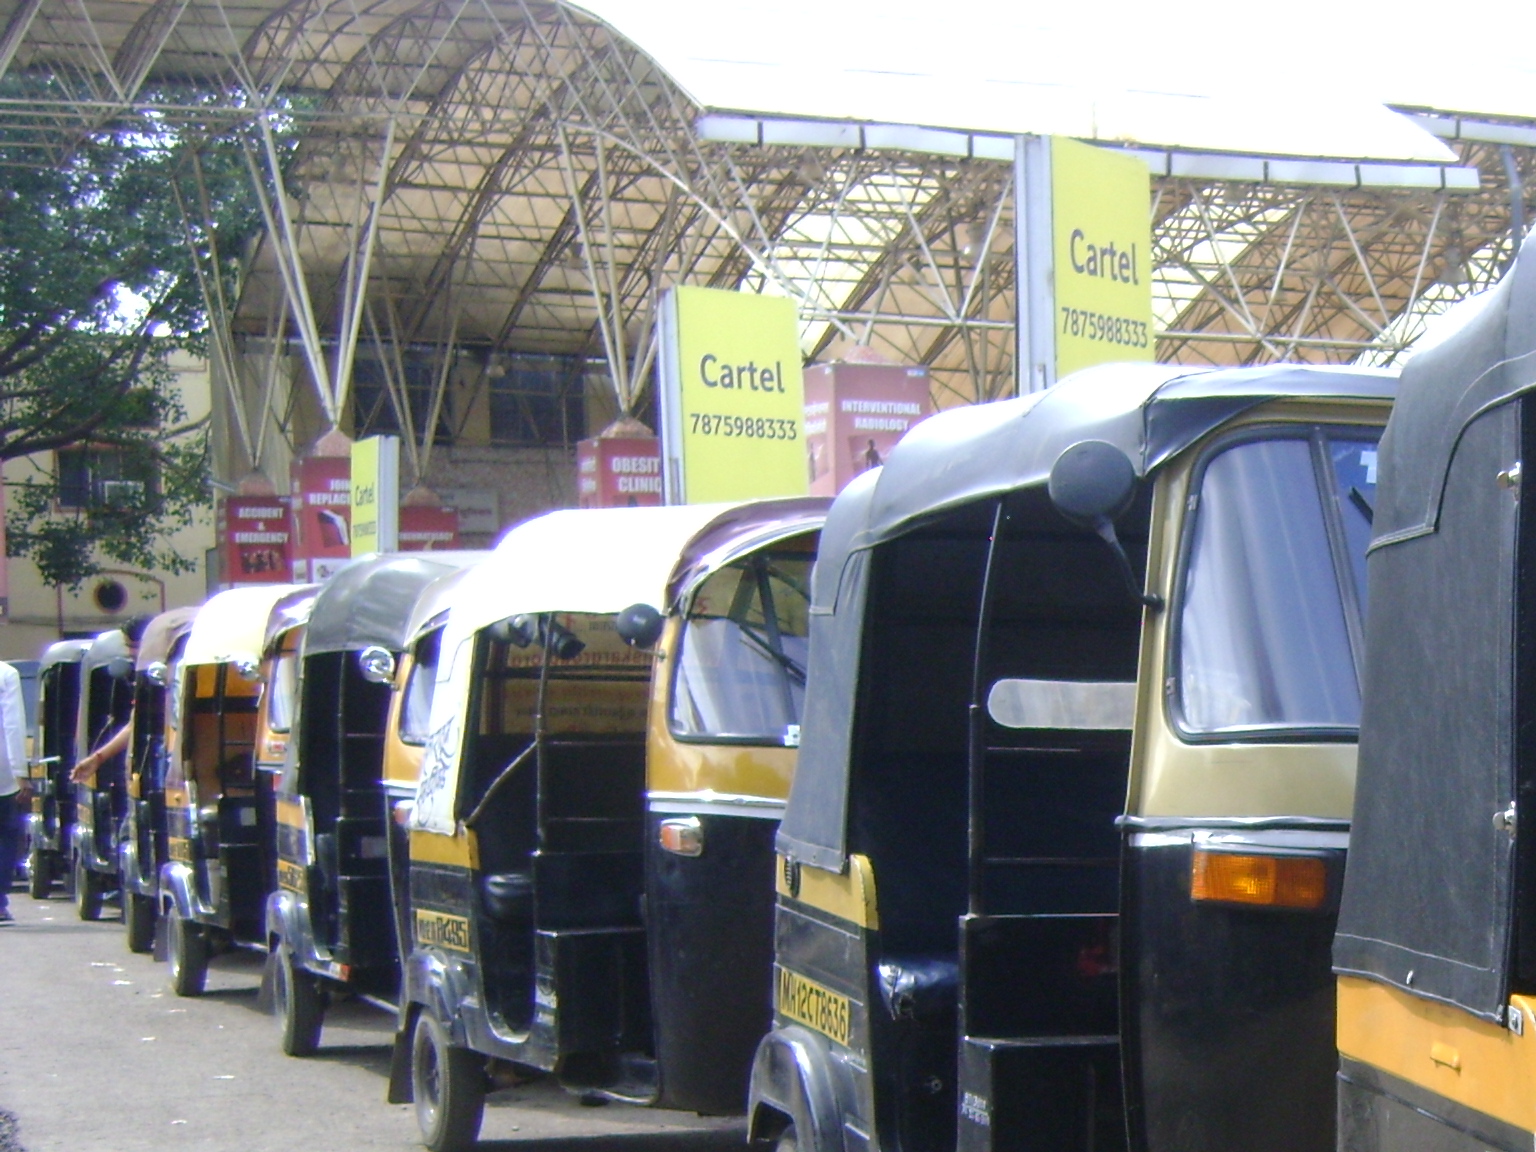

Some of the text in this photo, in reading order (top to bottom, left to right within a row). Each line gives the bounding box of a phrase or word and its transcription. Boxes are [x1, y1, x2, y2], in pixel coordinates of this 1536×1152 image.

[1070, 228, 1139, 286] Cartel
[1061, 306, 1148, 349] 7875988333
[700, 353, 785, 393] Cartel
[842, 399, 921, 415] INTERVENTIONAL
[690, 413, 797, 441] 7875988333
[854, 417, 909, 431] RADIOLOGY
[239, 507, 284, 518] ACCIDENT
[235, 532, 289, 544] EMERGENCY
